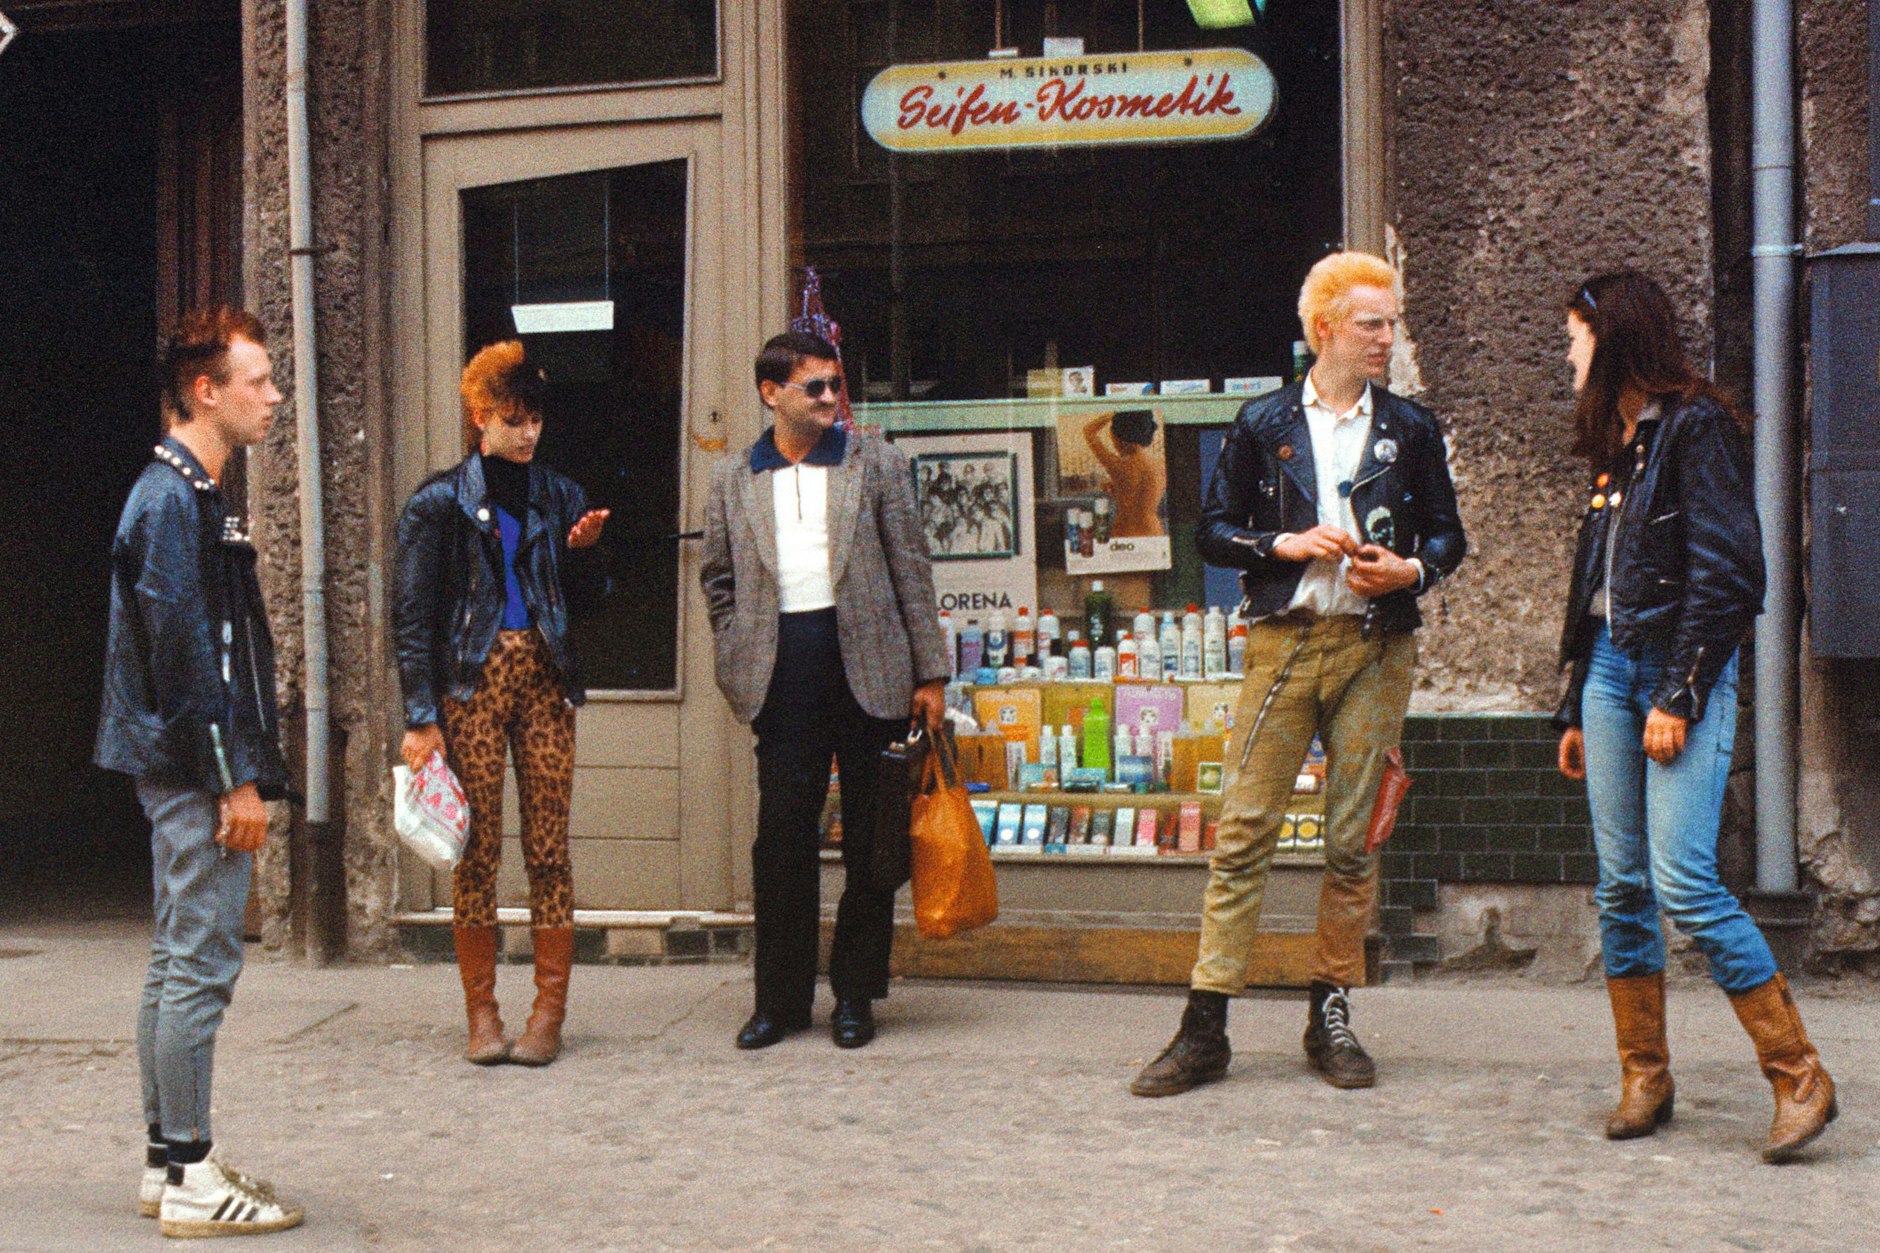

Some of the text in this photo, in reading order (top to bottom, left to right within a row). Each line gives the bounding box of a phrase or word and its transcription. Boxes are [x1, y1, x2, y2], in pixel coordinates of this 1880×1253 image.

[897, 72, 1242, 136] Seifen-Kosmetik
[1109, 541, 1135, 552] deo
[934, 592, 1012, 611] ORENA
